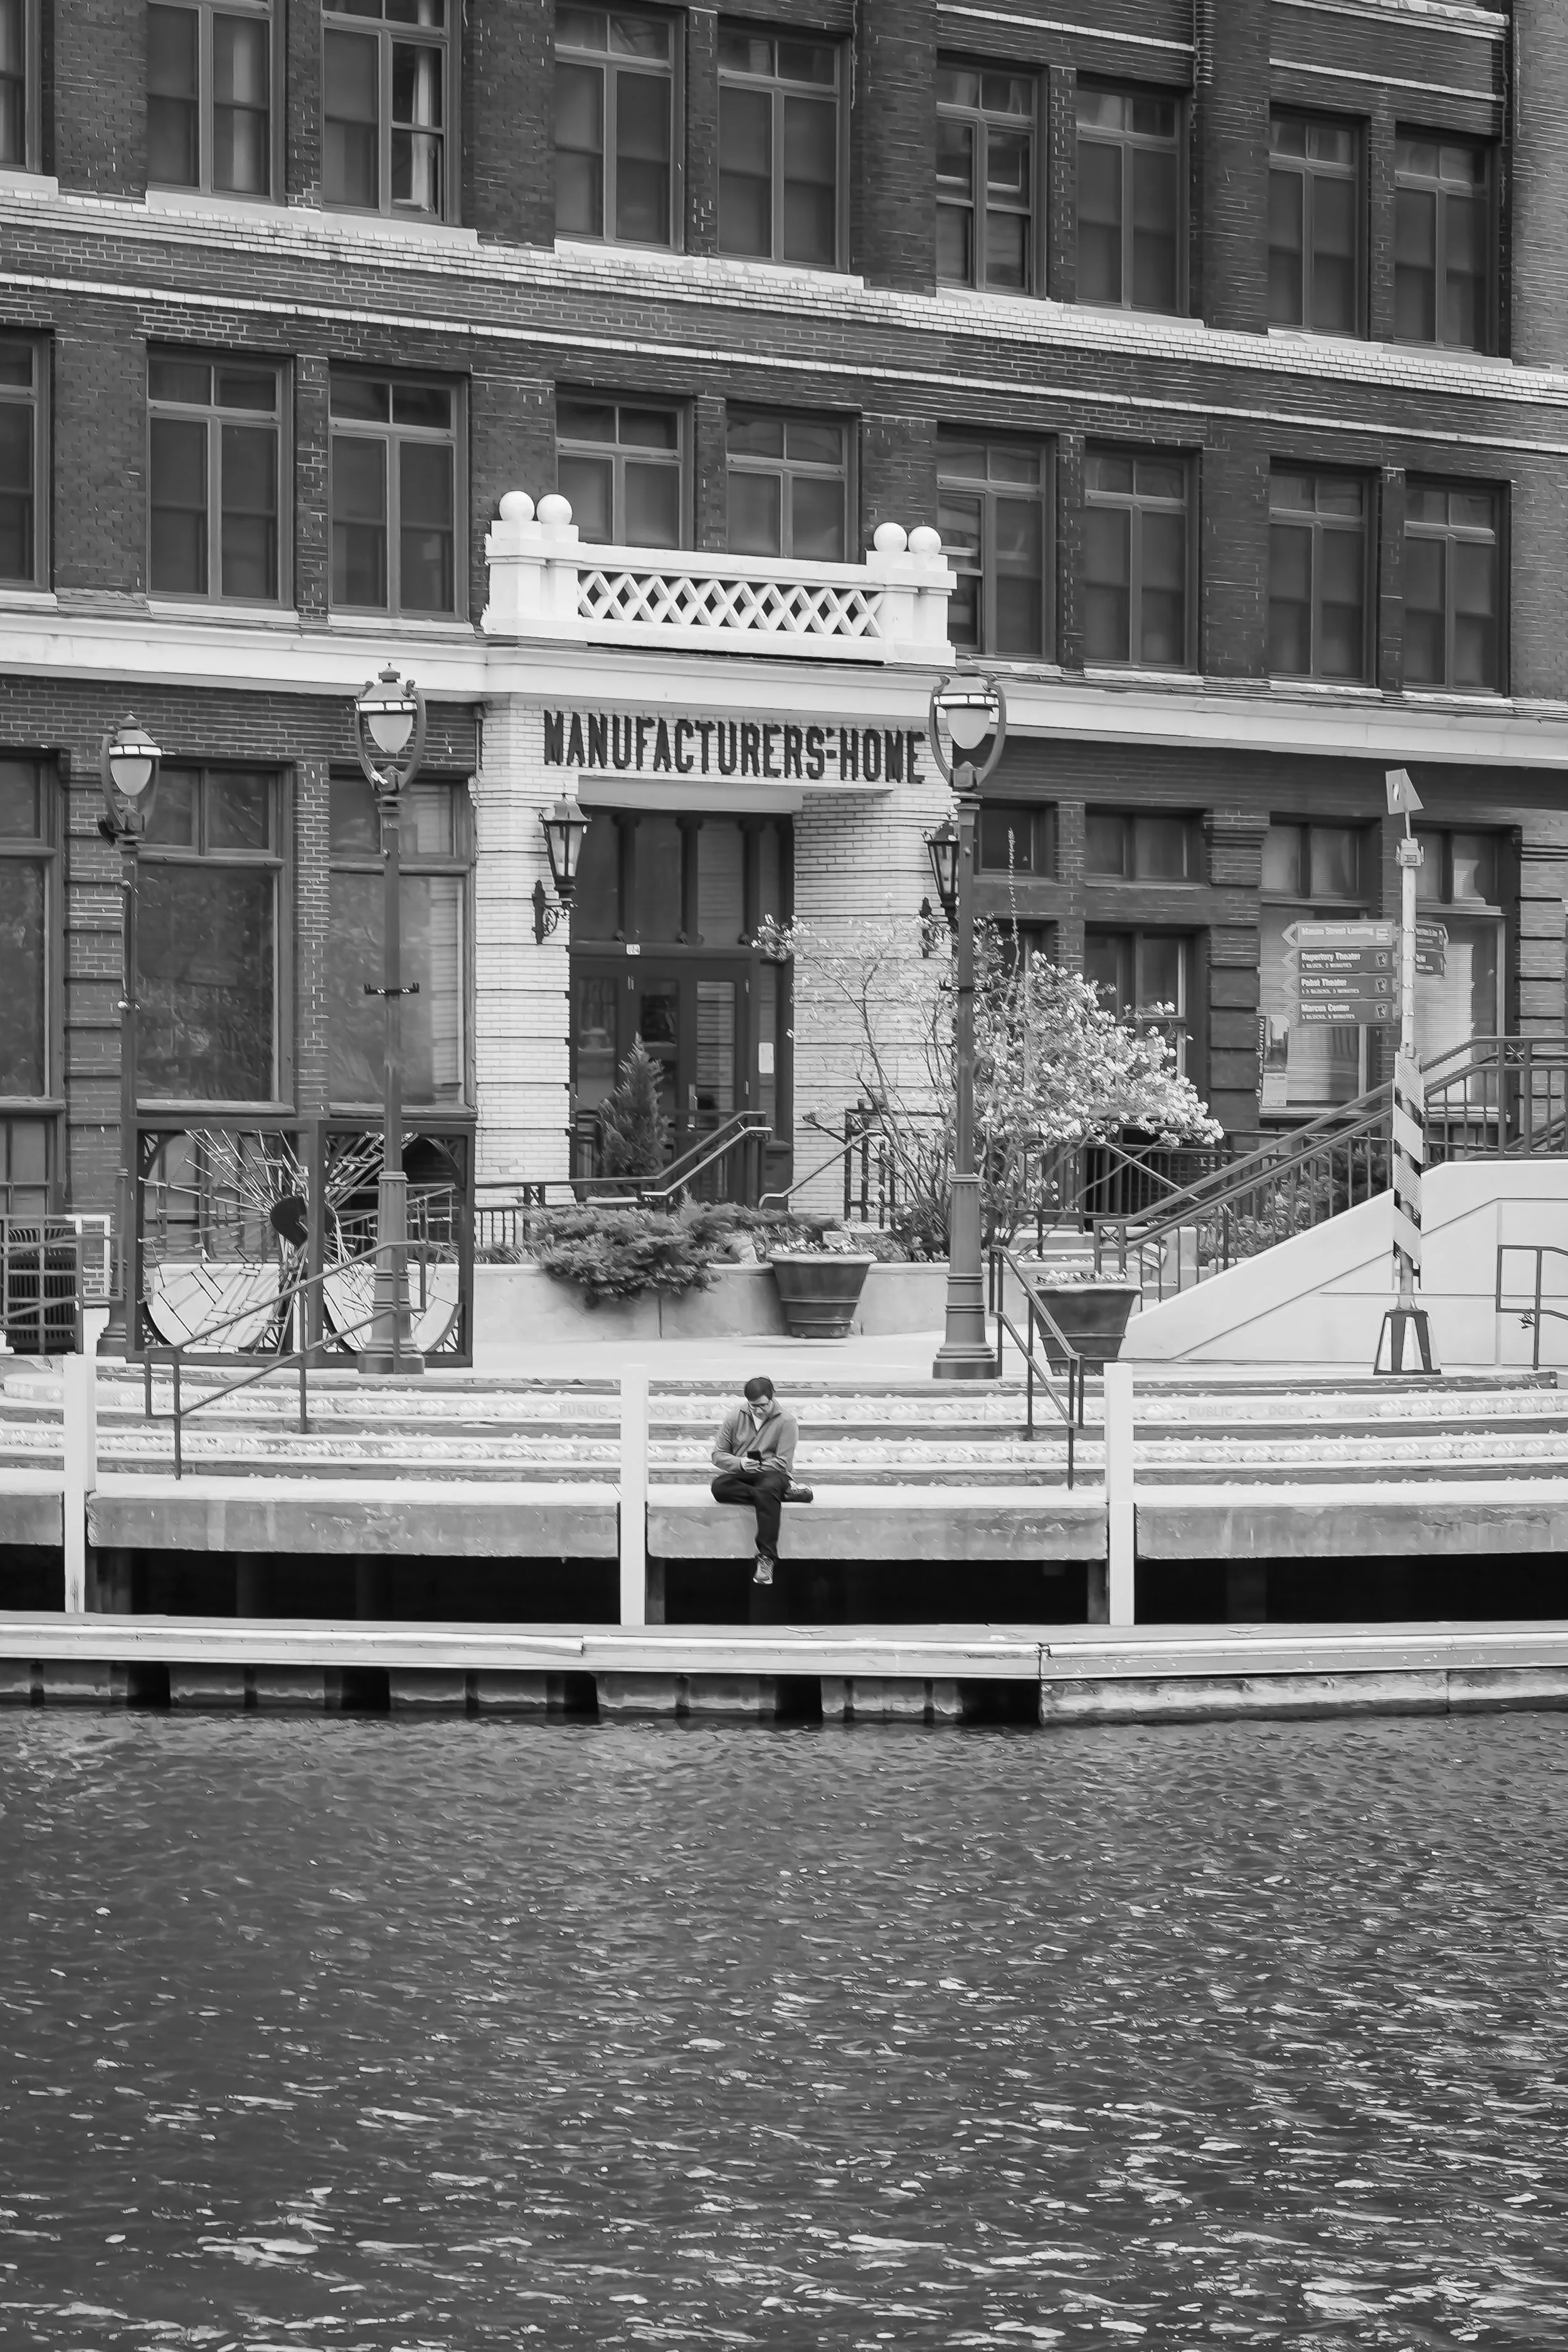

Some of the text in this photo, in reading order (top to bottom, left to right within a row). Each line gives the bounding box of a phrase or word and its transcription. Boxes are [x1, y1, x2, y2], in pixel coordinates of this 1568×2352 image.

[1301, 951, 1361, 962] Repertory Theater
[1321, 978, 1348, 987] Theater
[1327, 1003, 1350, 1012] Center
[559, 1403, 608, 1416] PUBLIC
[1189, 1405, 1234, 1417] PUBLIC
[1268, 1404, 1305, 1416] DOCK
